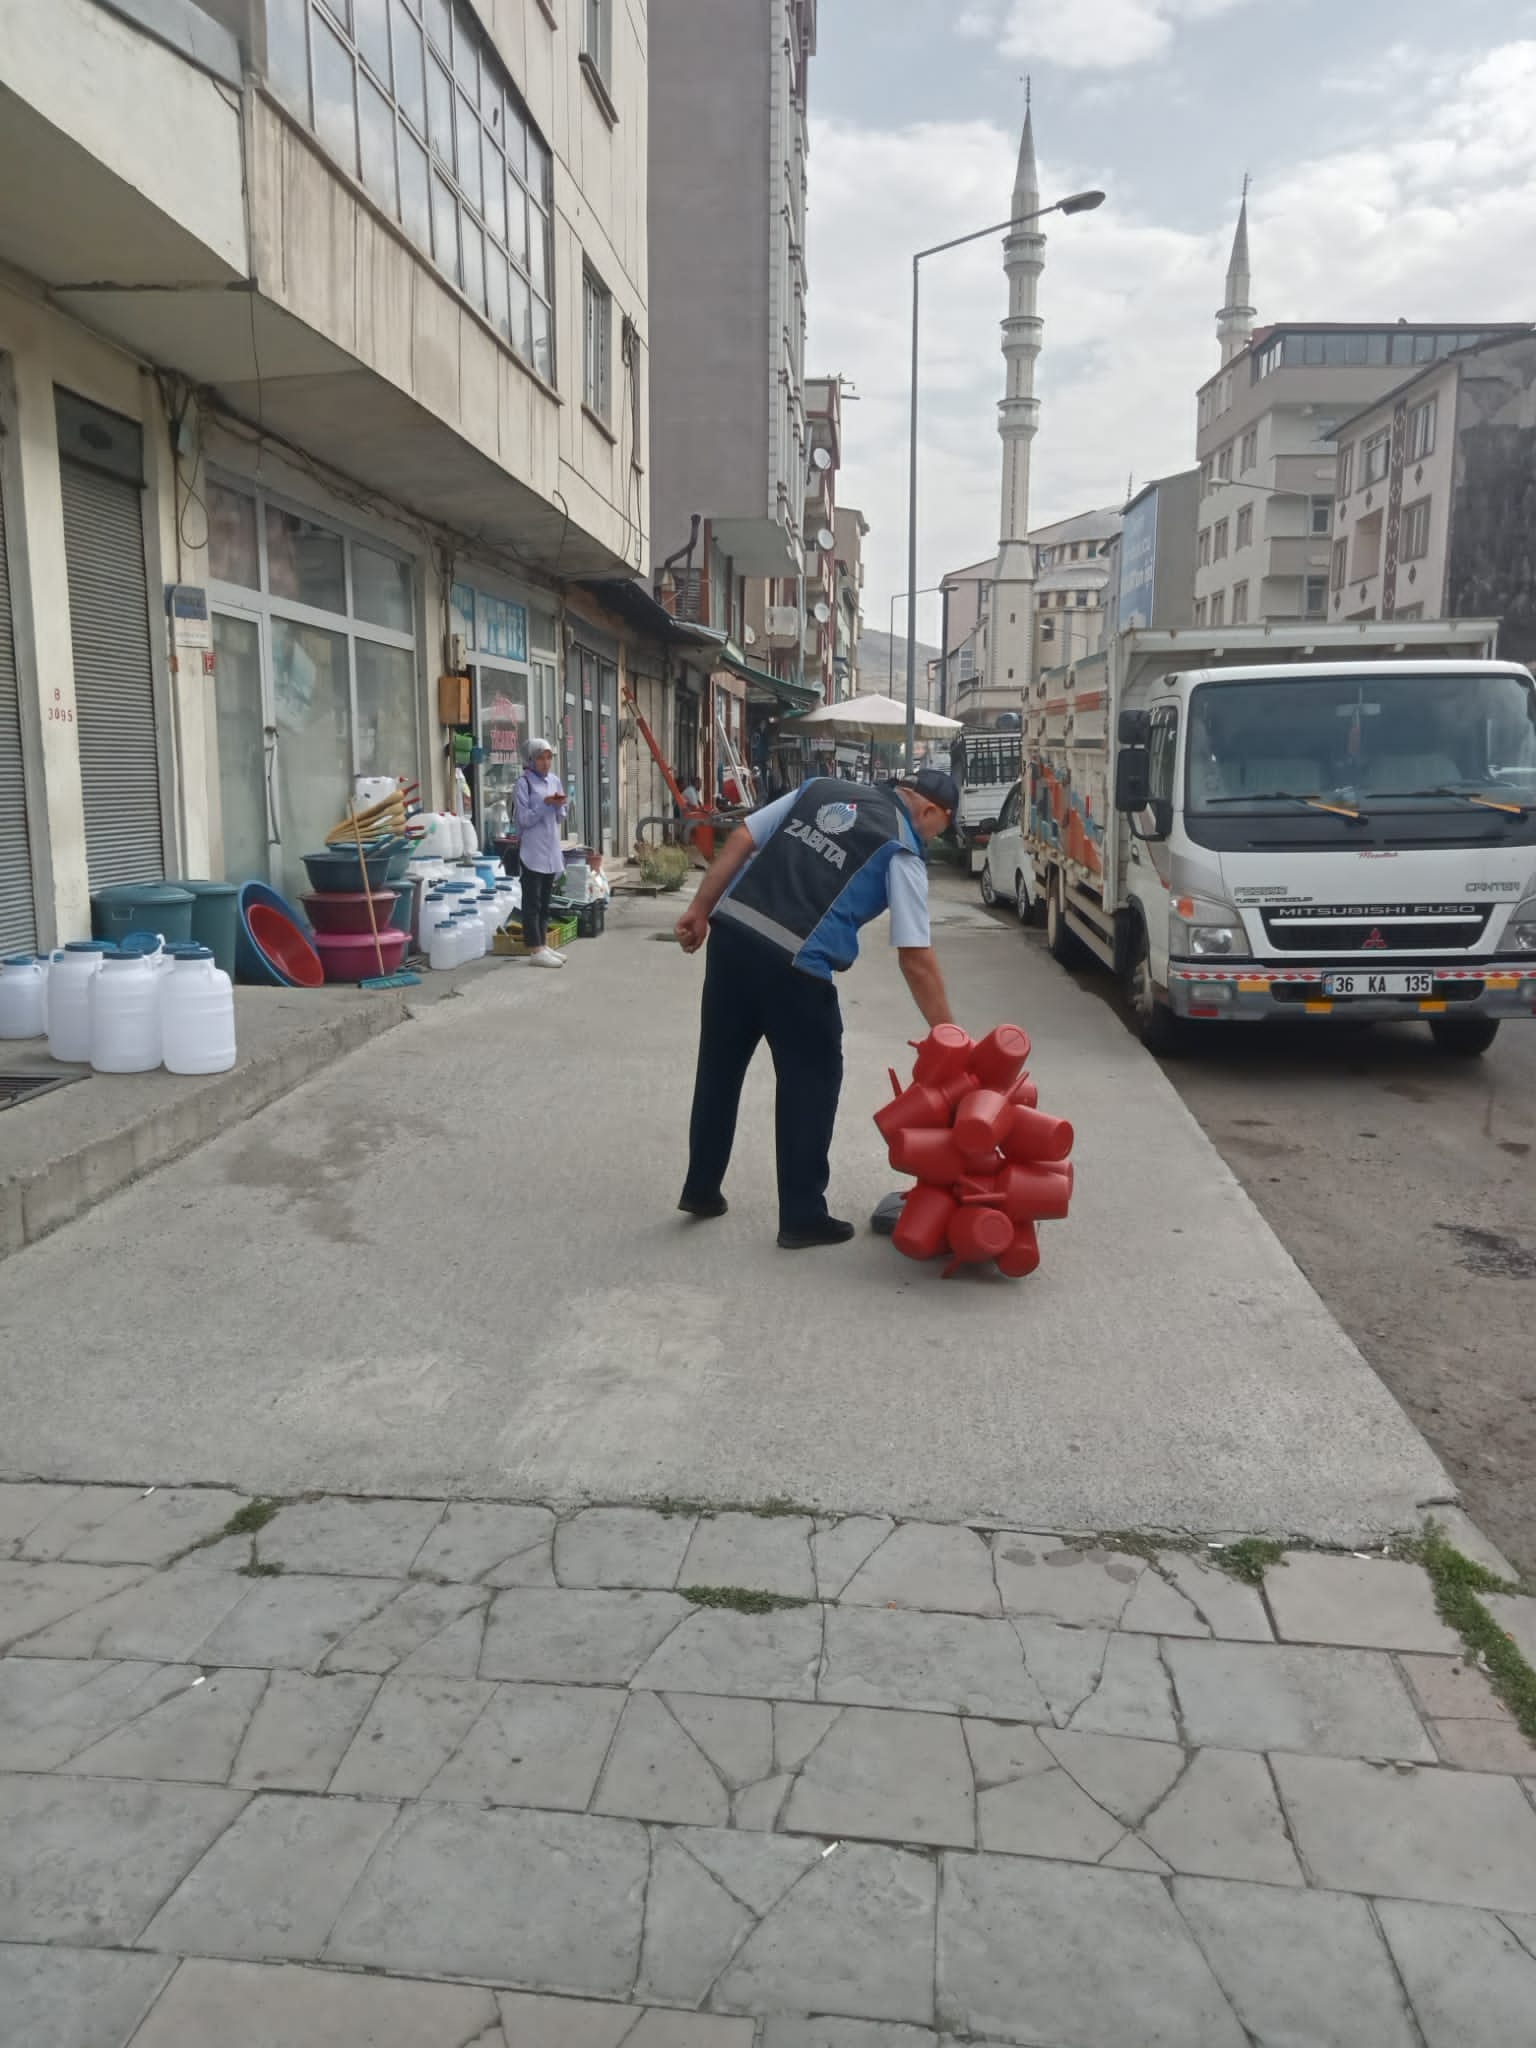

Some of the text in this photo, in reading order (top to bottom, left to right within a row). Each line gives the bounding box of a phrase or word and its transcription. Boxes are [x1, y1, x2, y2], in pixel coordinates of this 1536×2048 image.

[783, 818, 848, 871] ZABITA
[1279, 905, 1476, 917] MITSUBISHI FUSO
[1335, 975, 1430, 993] 36 KA 135
